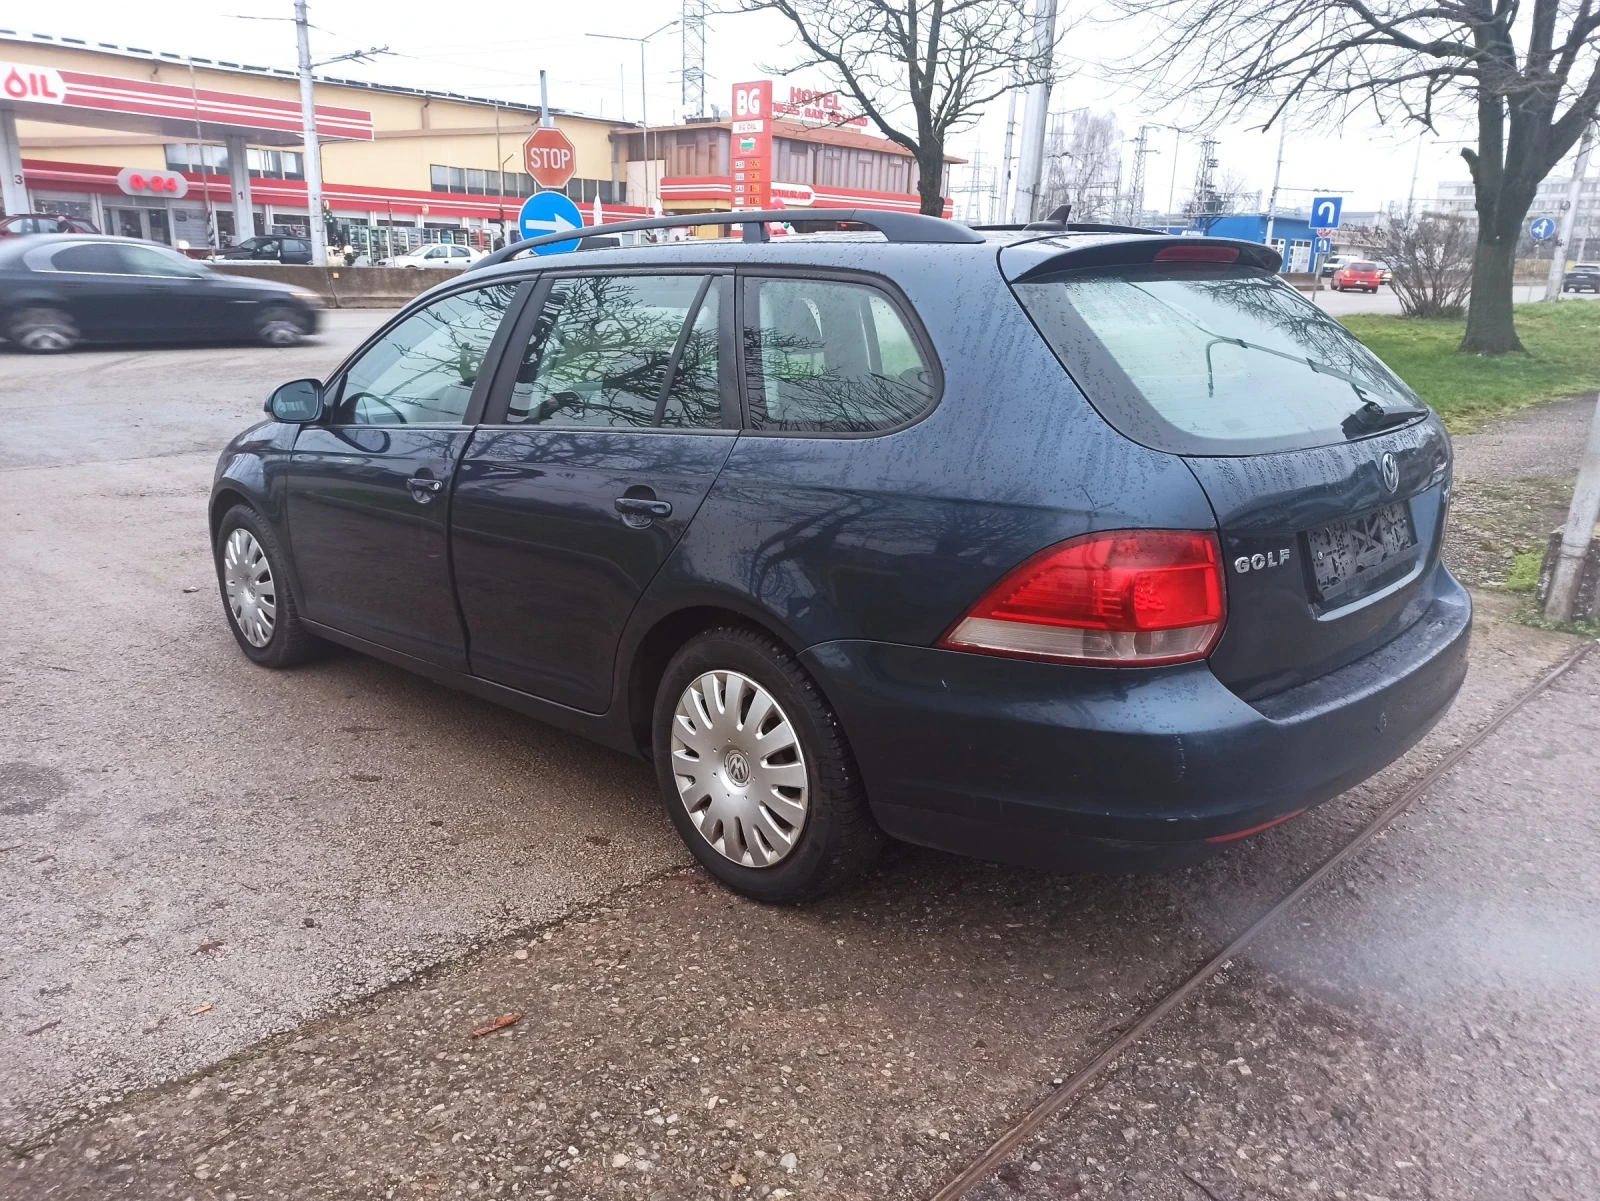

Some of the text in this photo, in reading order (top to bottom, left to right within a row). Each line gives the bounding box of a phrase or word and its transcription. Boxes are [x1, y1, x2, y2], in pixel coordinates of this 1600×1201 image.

[4, 67, 58, 98] OIL
[736, 88, 761, 115] BG
[790, 86, 842, 111] HOTEL
[530, 147, 571, 169] STOP
[14, 174, 23, 185] 3
[129, 173, 178, 192] 0-24
[238, 190, 244, 200] 1
[1234, 548, 1291, 574] GOLF
